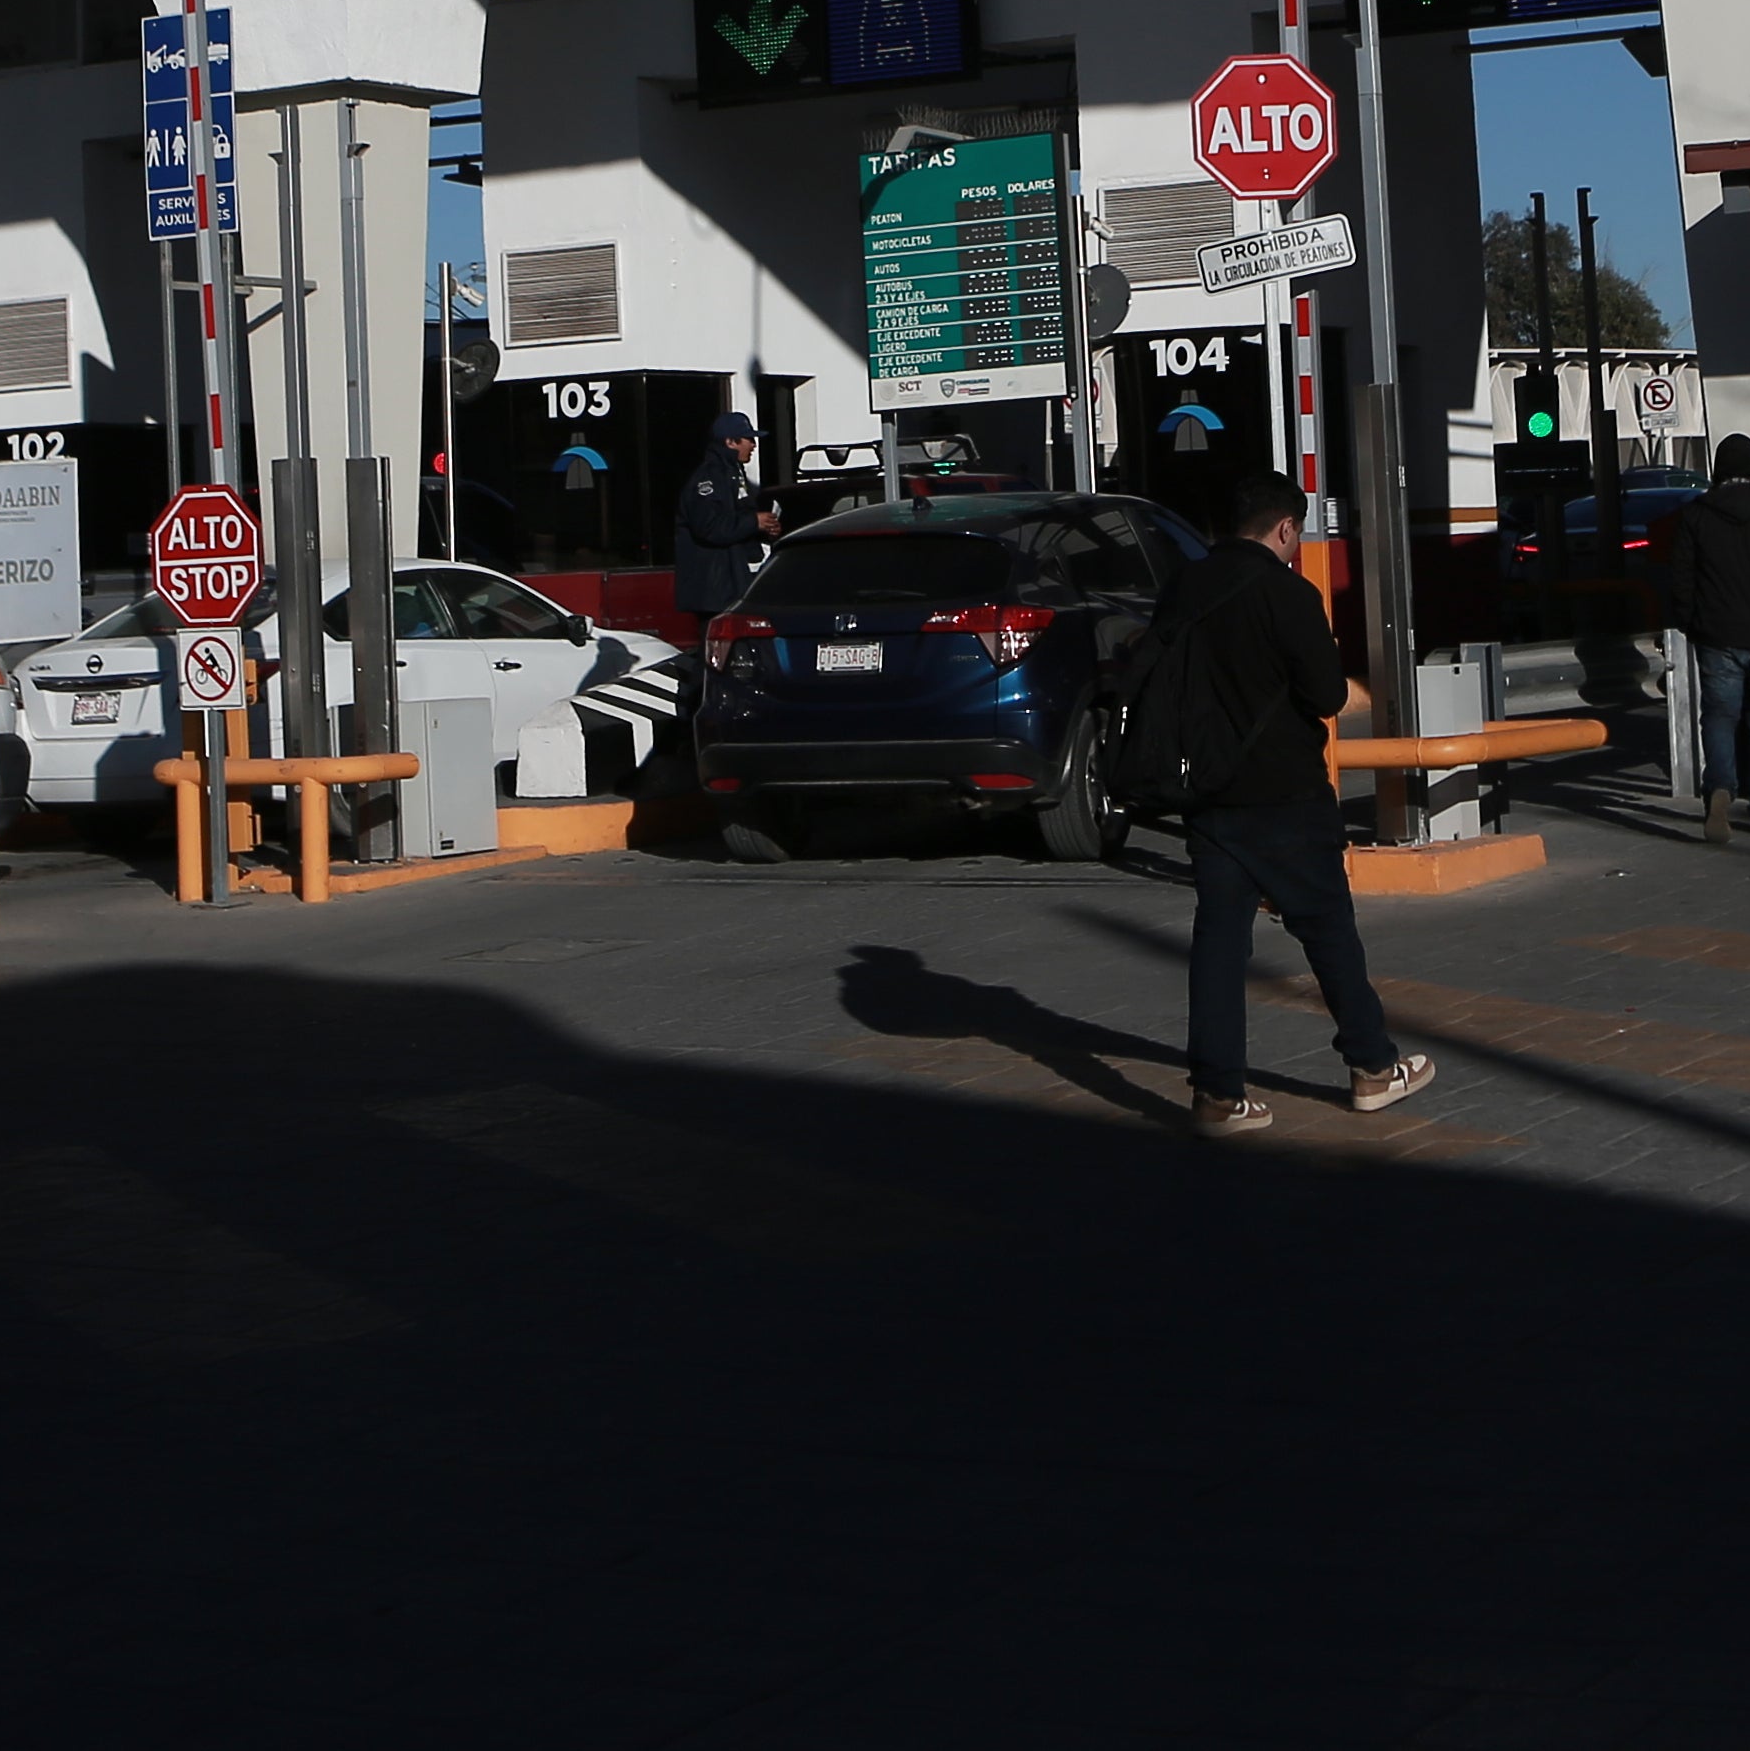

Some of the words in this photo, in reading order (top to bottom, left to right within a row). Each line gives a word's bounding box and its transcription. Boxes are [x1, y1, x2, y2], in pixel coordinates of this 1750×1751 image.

[1208, 103, 1324, 154] ALTO
[961, 186, 997, 198] PESOS
[1007, 179, 1055, 194] DOLARES
[871, 212, 902, 226] PEATON
[872, 235, 932, 251] MOTOCICLETAS
[1221, 228, 1324, 263] PROHIBIDA
[874, 264, 900, 275] AUTOS
[1209, 270, 1221, 286] LA
[1224, 256, 1282, 282] CIRCULACIÓN
[1286, 253, 1299, 268] DE
[1301, 242, 1345, 265] PEATONES
[875, 281, 913, 293] AUTOBUS
[905, 291, 925, 301] EJES
[907, 306, 918, 316] DE
[920, 304, 949, 315] CARGA
[898, 316, 919, 327] EJES
[877, 332, 892, 342] EJE
[894, 327, 941, 340] EXCEDENTE
[878, 342, 906, 353] LIGERO
[878, 357, 893, 367] EJE
[895, 352, 943, 365] EXCEDENTE
[1149, 336, 1230, 377] 104
[879, 368, 889, 378] DE
[891, 366, 919, 377] CARGA
[898, 380, 922, 393] SCT
[541, 381, 611, 419] 103
[7, 432, 66, 460] 102
[167, 514, 243, 552] ALTO
[170, 564, 249, 602] STOP
